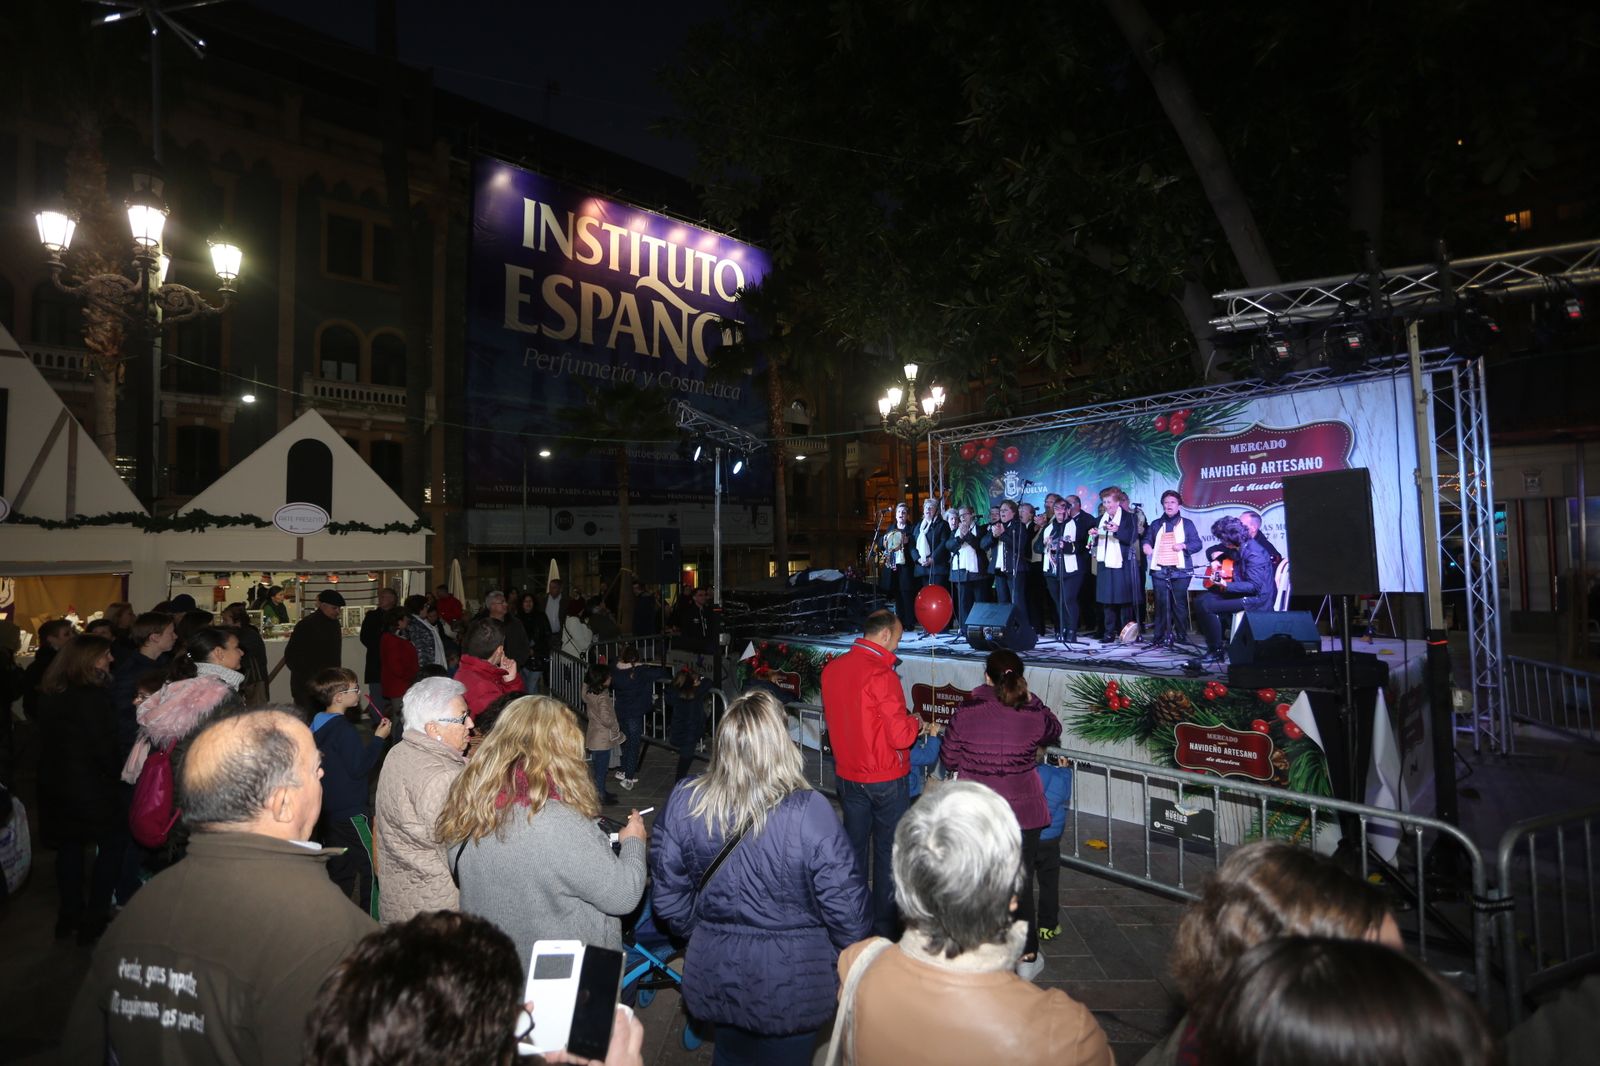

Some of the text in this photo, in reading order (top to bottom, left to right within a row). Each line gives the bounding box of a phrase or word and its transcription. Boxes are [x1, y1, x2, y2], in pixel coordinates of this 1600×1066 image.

[522, 196, 746, 312] INSTITUTO
[522, 346, 636, 384] Perfumería
[641, 370, 653, 391] y
[1230, 438, 1287, 454] MERCADO
[1200, 456, 1324, 480] NAVIDEÑO ARTESANO
[1229, 480, 1284, 493] de Huelv
[936, 692, 964, 702] MERCADO
[922, 703, 950, 715] NAVDEÑO
[1206, 732, 1239, 743] MERCADO
[1189, 742, 1258, 760] NAVIDEÑO ARTESANO
